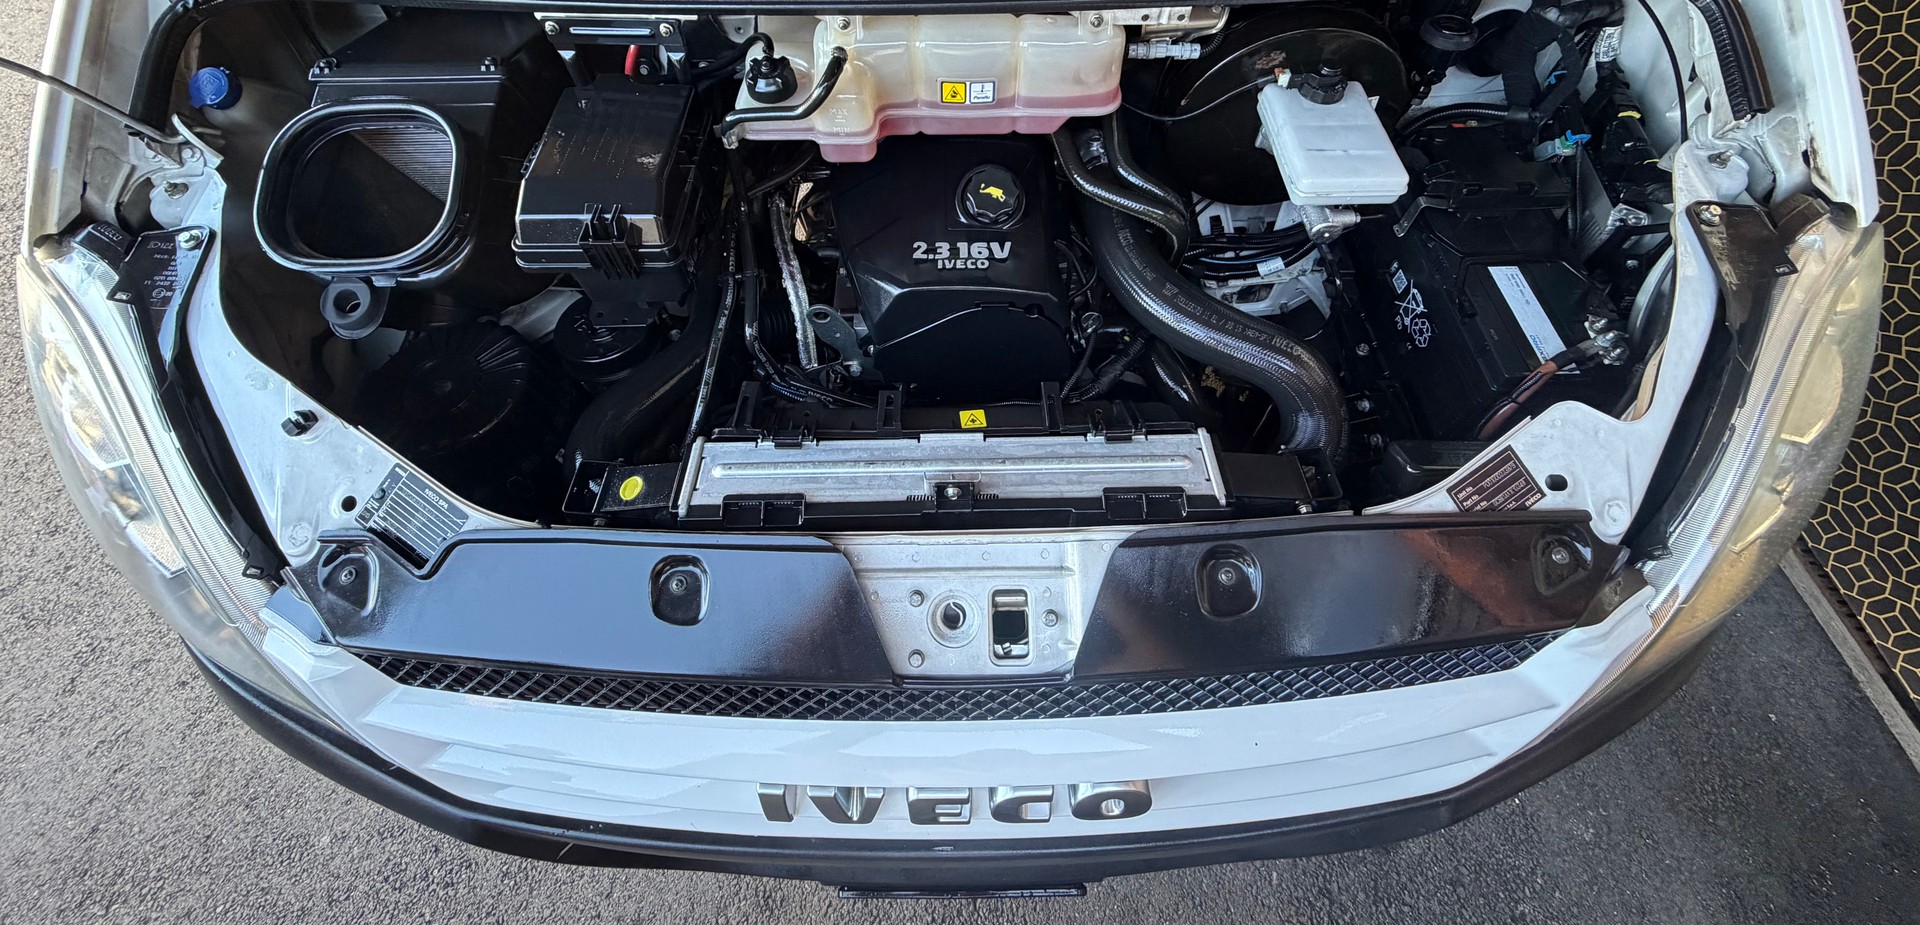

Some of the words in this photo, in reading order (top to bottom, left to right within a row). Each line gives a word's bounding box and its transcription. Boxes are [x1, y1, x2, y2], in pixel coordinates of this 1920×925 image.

[829, 108, 849, 116] MAX
[833, 126, 850, 134] MIN
[912, 241, 951, 259] 2.3
[956, 241, 1012, 259] 16V
[937, 259, 990, 269] IVECO
[424, 488, 442, 504] IVECO
[438, 498, 449, 510] SPA
[1524, 492, 1542, 507] IVECO
[756, 780, 1153, 825] IVECO
